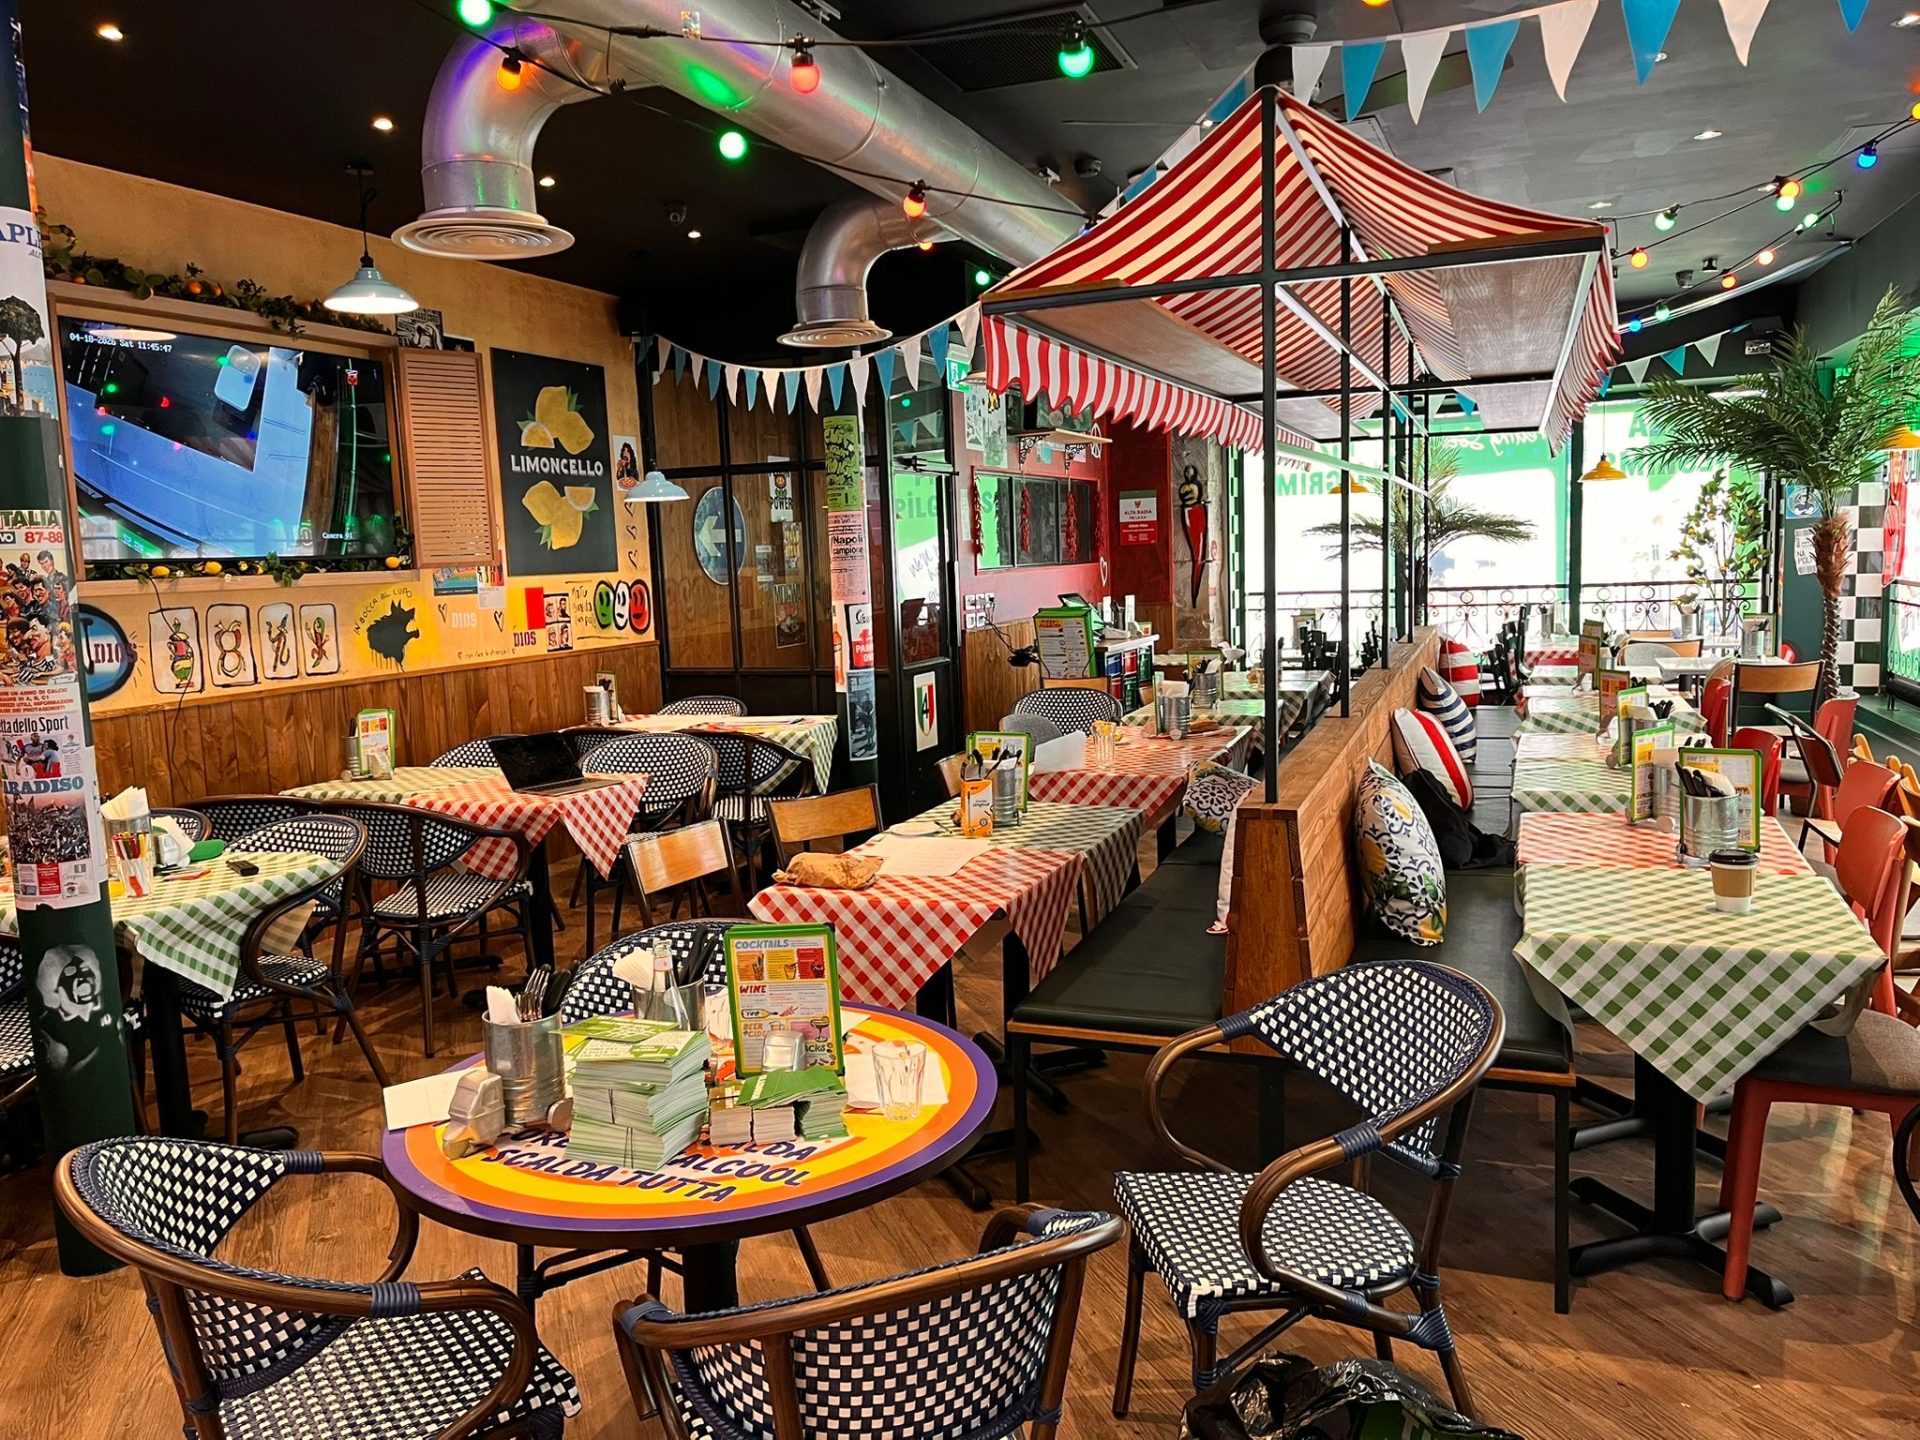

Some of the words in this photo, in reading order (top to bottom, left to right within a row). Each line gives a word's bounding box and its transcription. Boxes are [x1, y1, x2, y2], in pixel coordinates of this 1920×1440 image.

[119, 338, 134, 349] Sat
[137, 340, 172, 353] 11:45:47
[510, 454, 604, 477] LIMONCELLO
[24, 531, 64, 544] 87-88
[833, 534, 863, 546] Napoli
[359, 598, 378, 625] BOCCA
[921, 692, 930, 719] 4
[12, 717, 38, 733] dello
[39, 714, 69, 735] Sport
[735, 938, 789, 950] COCKTAILS
[739, 984, 768, 994] WINE
[743, 1022, 764, 1031] BEER
[481, 1149, 619, 1181] SCALDA
[618, 1169, 737, 1202] TUTTA
